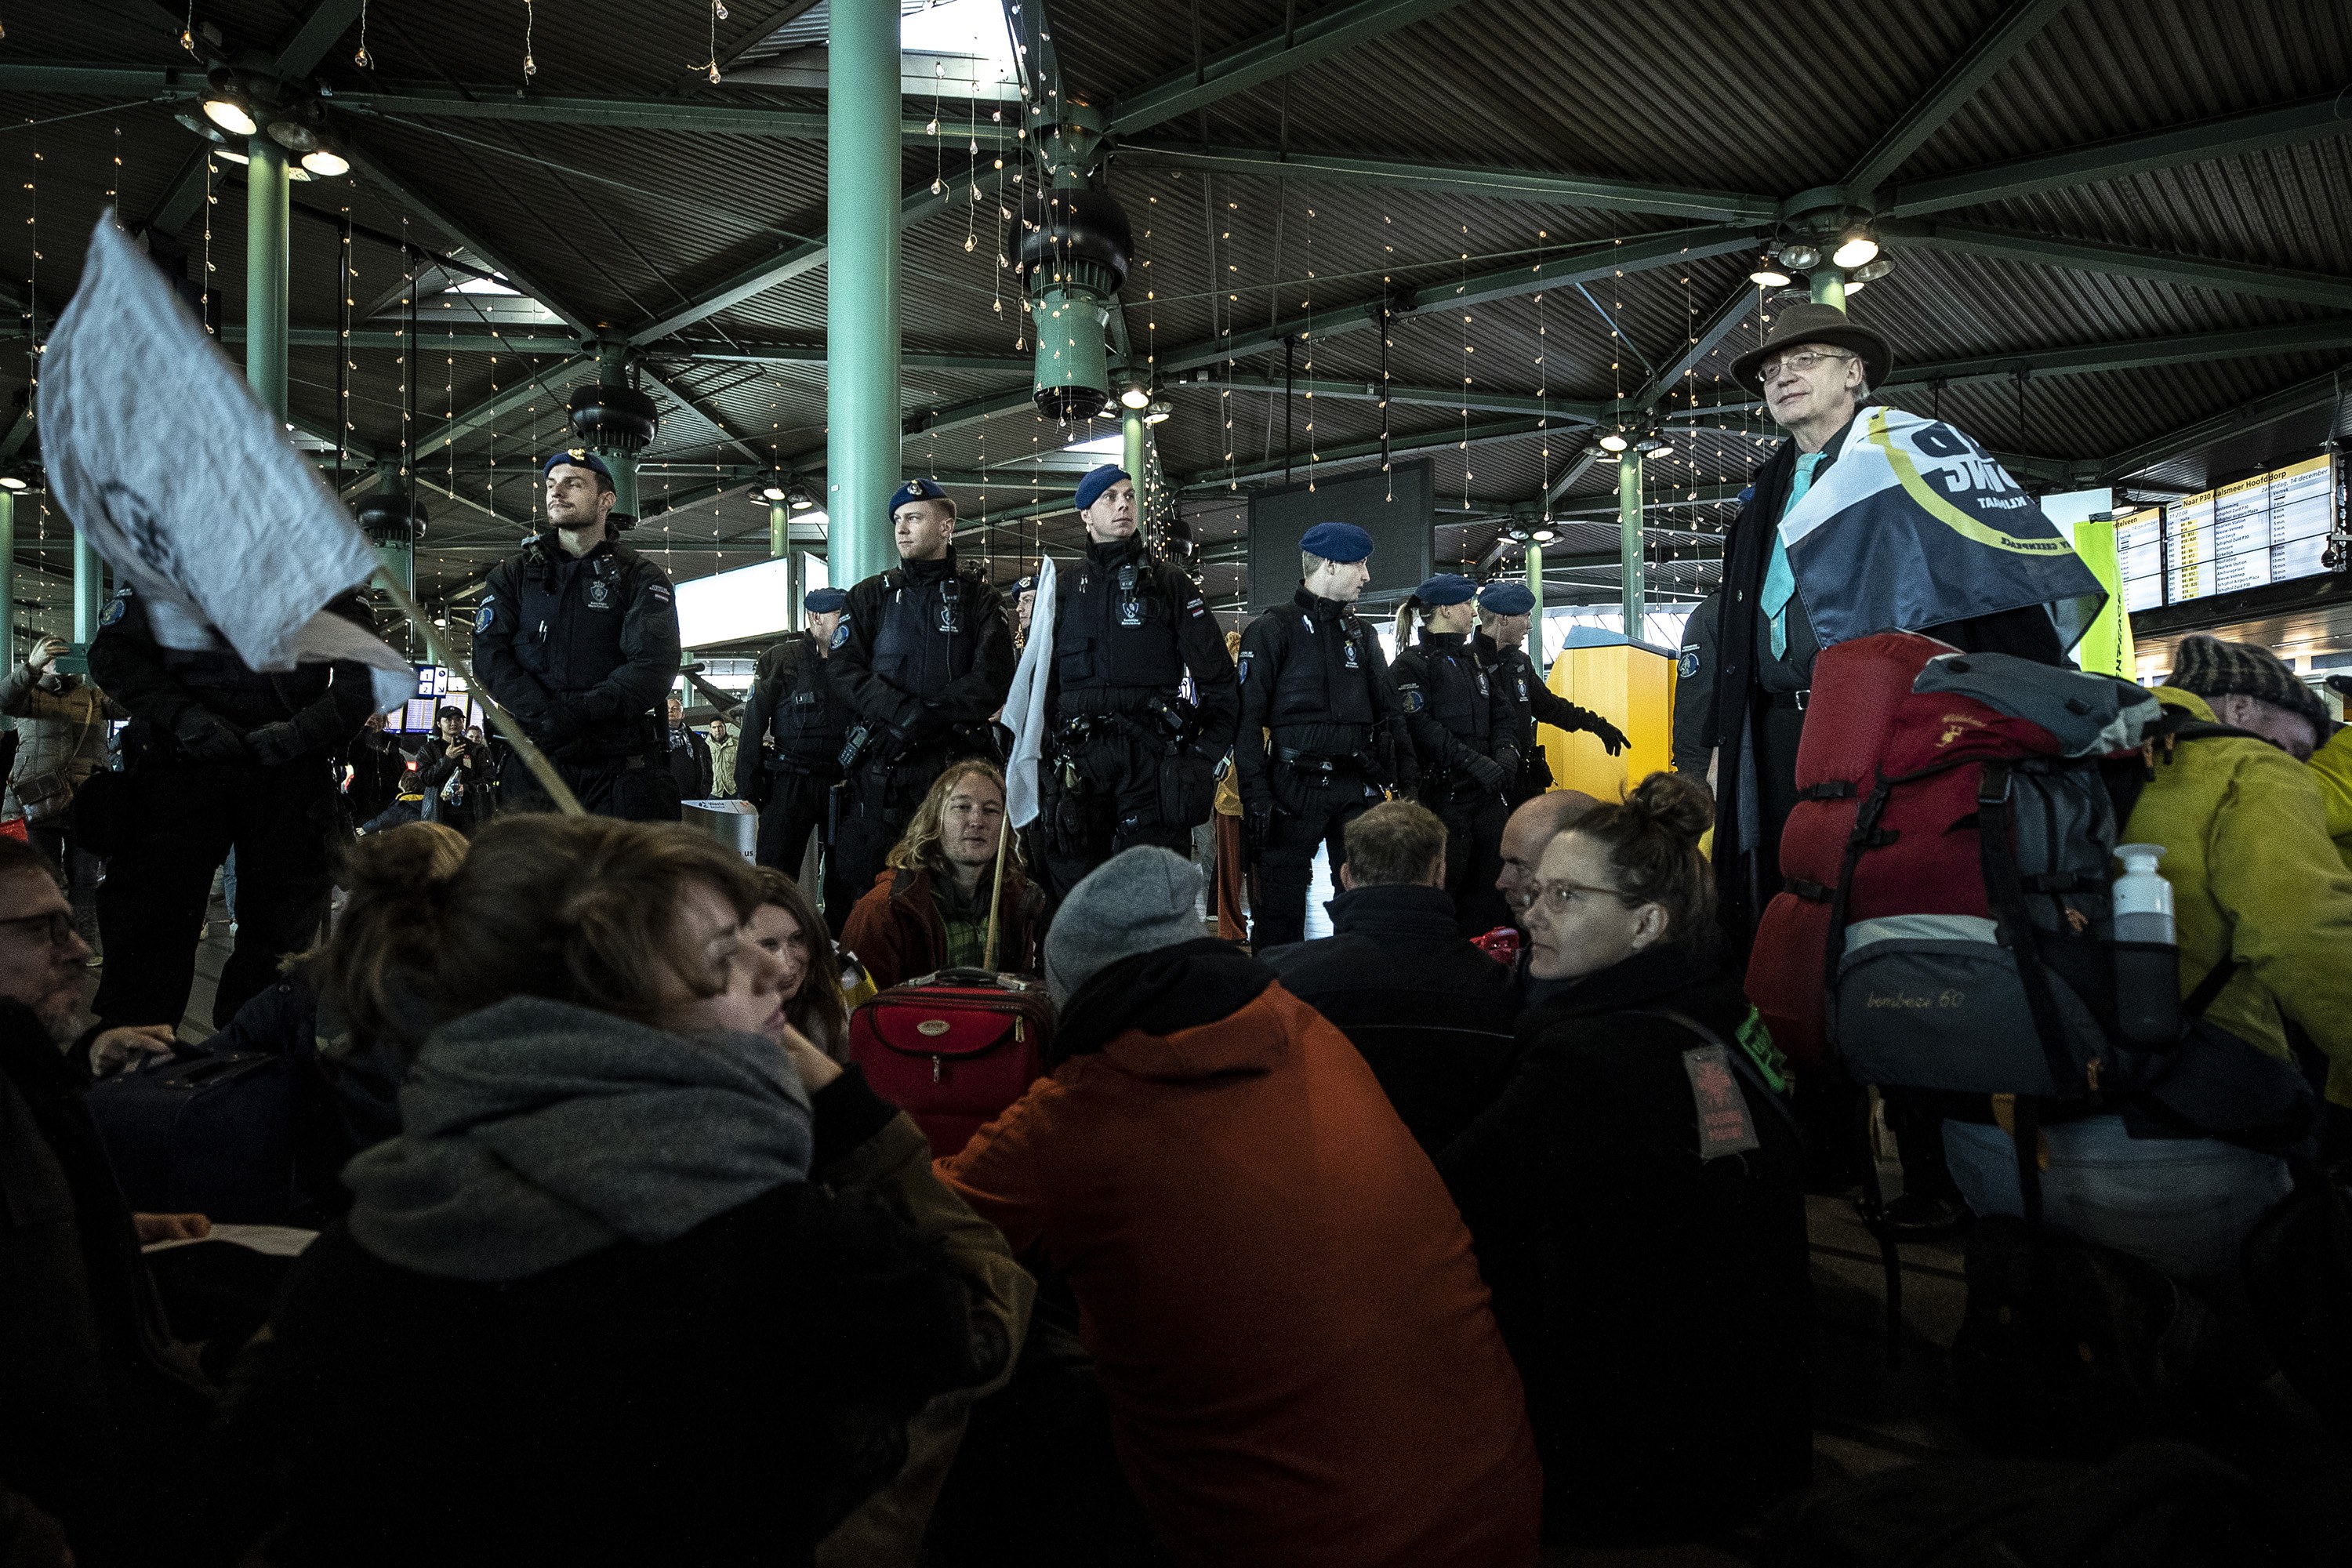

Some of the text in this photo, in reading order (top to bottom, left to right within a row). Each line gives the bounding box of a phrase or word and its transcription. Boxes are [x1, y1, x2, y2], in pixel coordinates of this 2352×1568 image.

[2183, 471, 2287, 506] Naar P30 Aalsmeer Hoofddorp
[2261, 481, 2288, 492] zaerdag,
[2298, 469, 2328, 481] december
